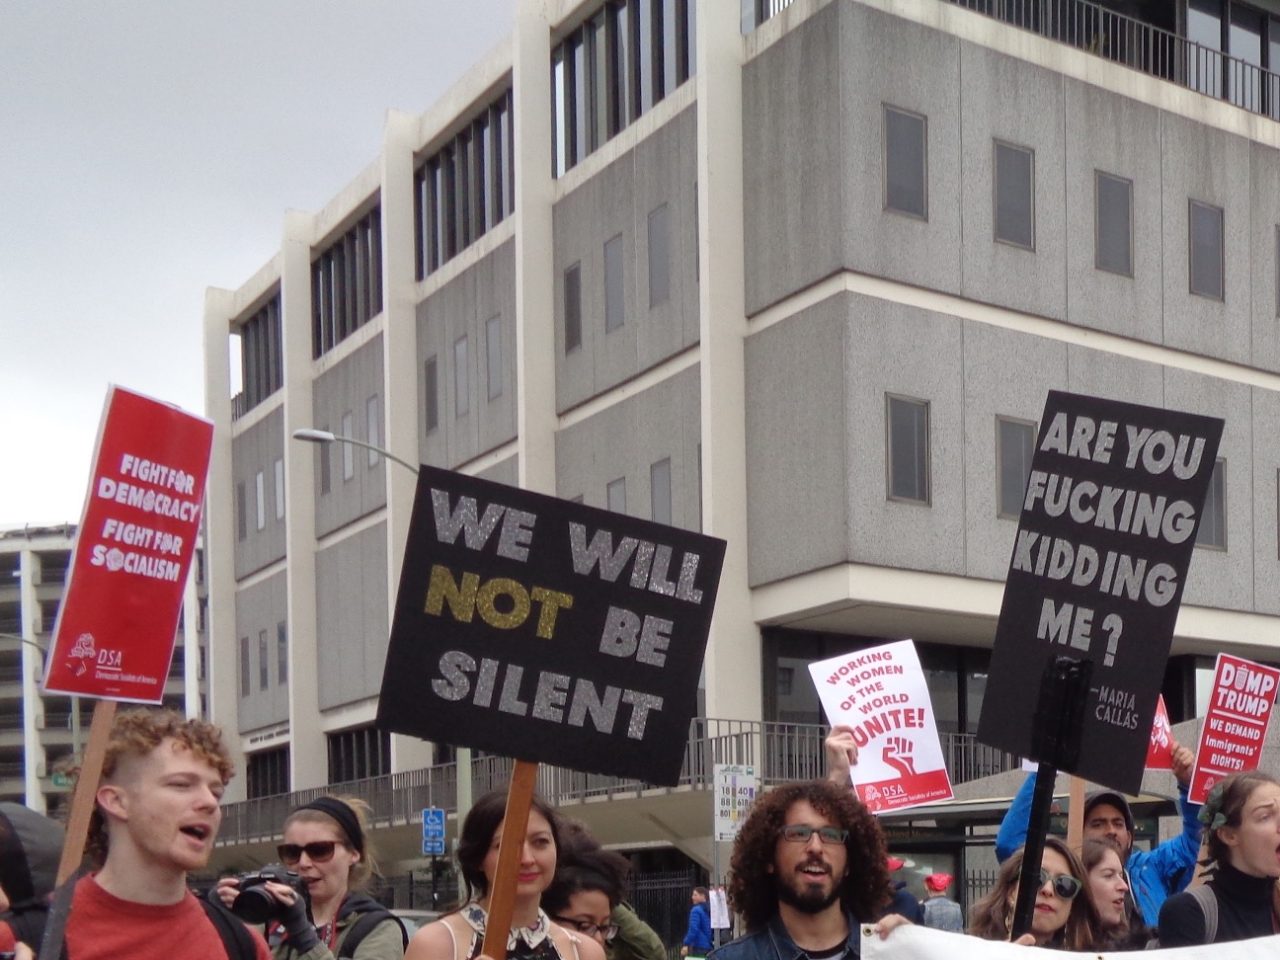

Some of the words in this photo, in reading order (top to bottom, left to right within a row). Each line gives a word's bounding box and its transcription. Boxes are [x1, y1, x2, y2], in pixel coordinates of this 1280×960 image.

[1040, 412, 1118, 464] ARE
[1125, 424, 1206, 480] YOU
[120, 453, 169, 490] FIGHT
[168, 470, 195, 496] FOR
[98, 476, 199, 523] DEMOCRACY
[1023, 470, 1195, 544] FUCKING
[102, 518, 154, 553] FIGHT
[154, 528, 183, 556] FOR
[431, 488, 537, 562] WE
[568, 521, 703, 604] WILL
[90, 545, 181, 583] SOCIALISM
[1012, 530, 1177, 607] KIDDING
[424, 564, 574, 639] NOT
[599, 606, 674, 667] BE
[1037, 597, 1094, 651] ME
[1102, 613, 1123, 667] ?
[97, 648, 122, 666] DSA
[827, 651, 892, 685] WORKING
[846, 665, 903, 687] WOMEN
[431, 650, 664, 740] SILENT
[840, 696, 857, 711] OF
[857, 681, 884, 698] THE
[859, 693, 909, 715] WORLD
[1217, 687, 1269, 717] TRUMP
[851, 708, 925, 748] UNITE!
[1095, 705, 1139, 730] CALLAS
[1210, 718, 1223, 732] WE
[1224, 722, 1260, 740] DEMAND
[1210, 753, 1244, 770] RIGHTS!
[882, 784, 904, 797] DSA
